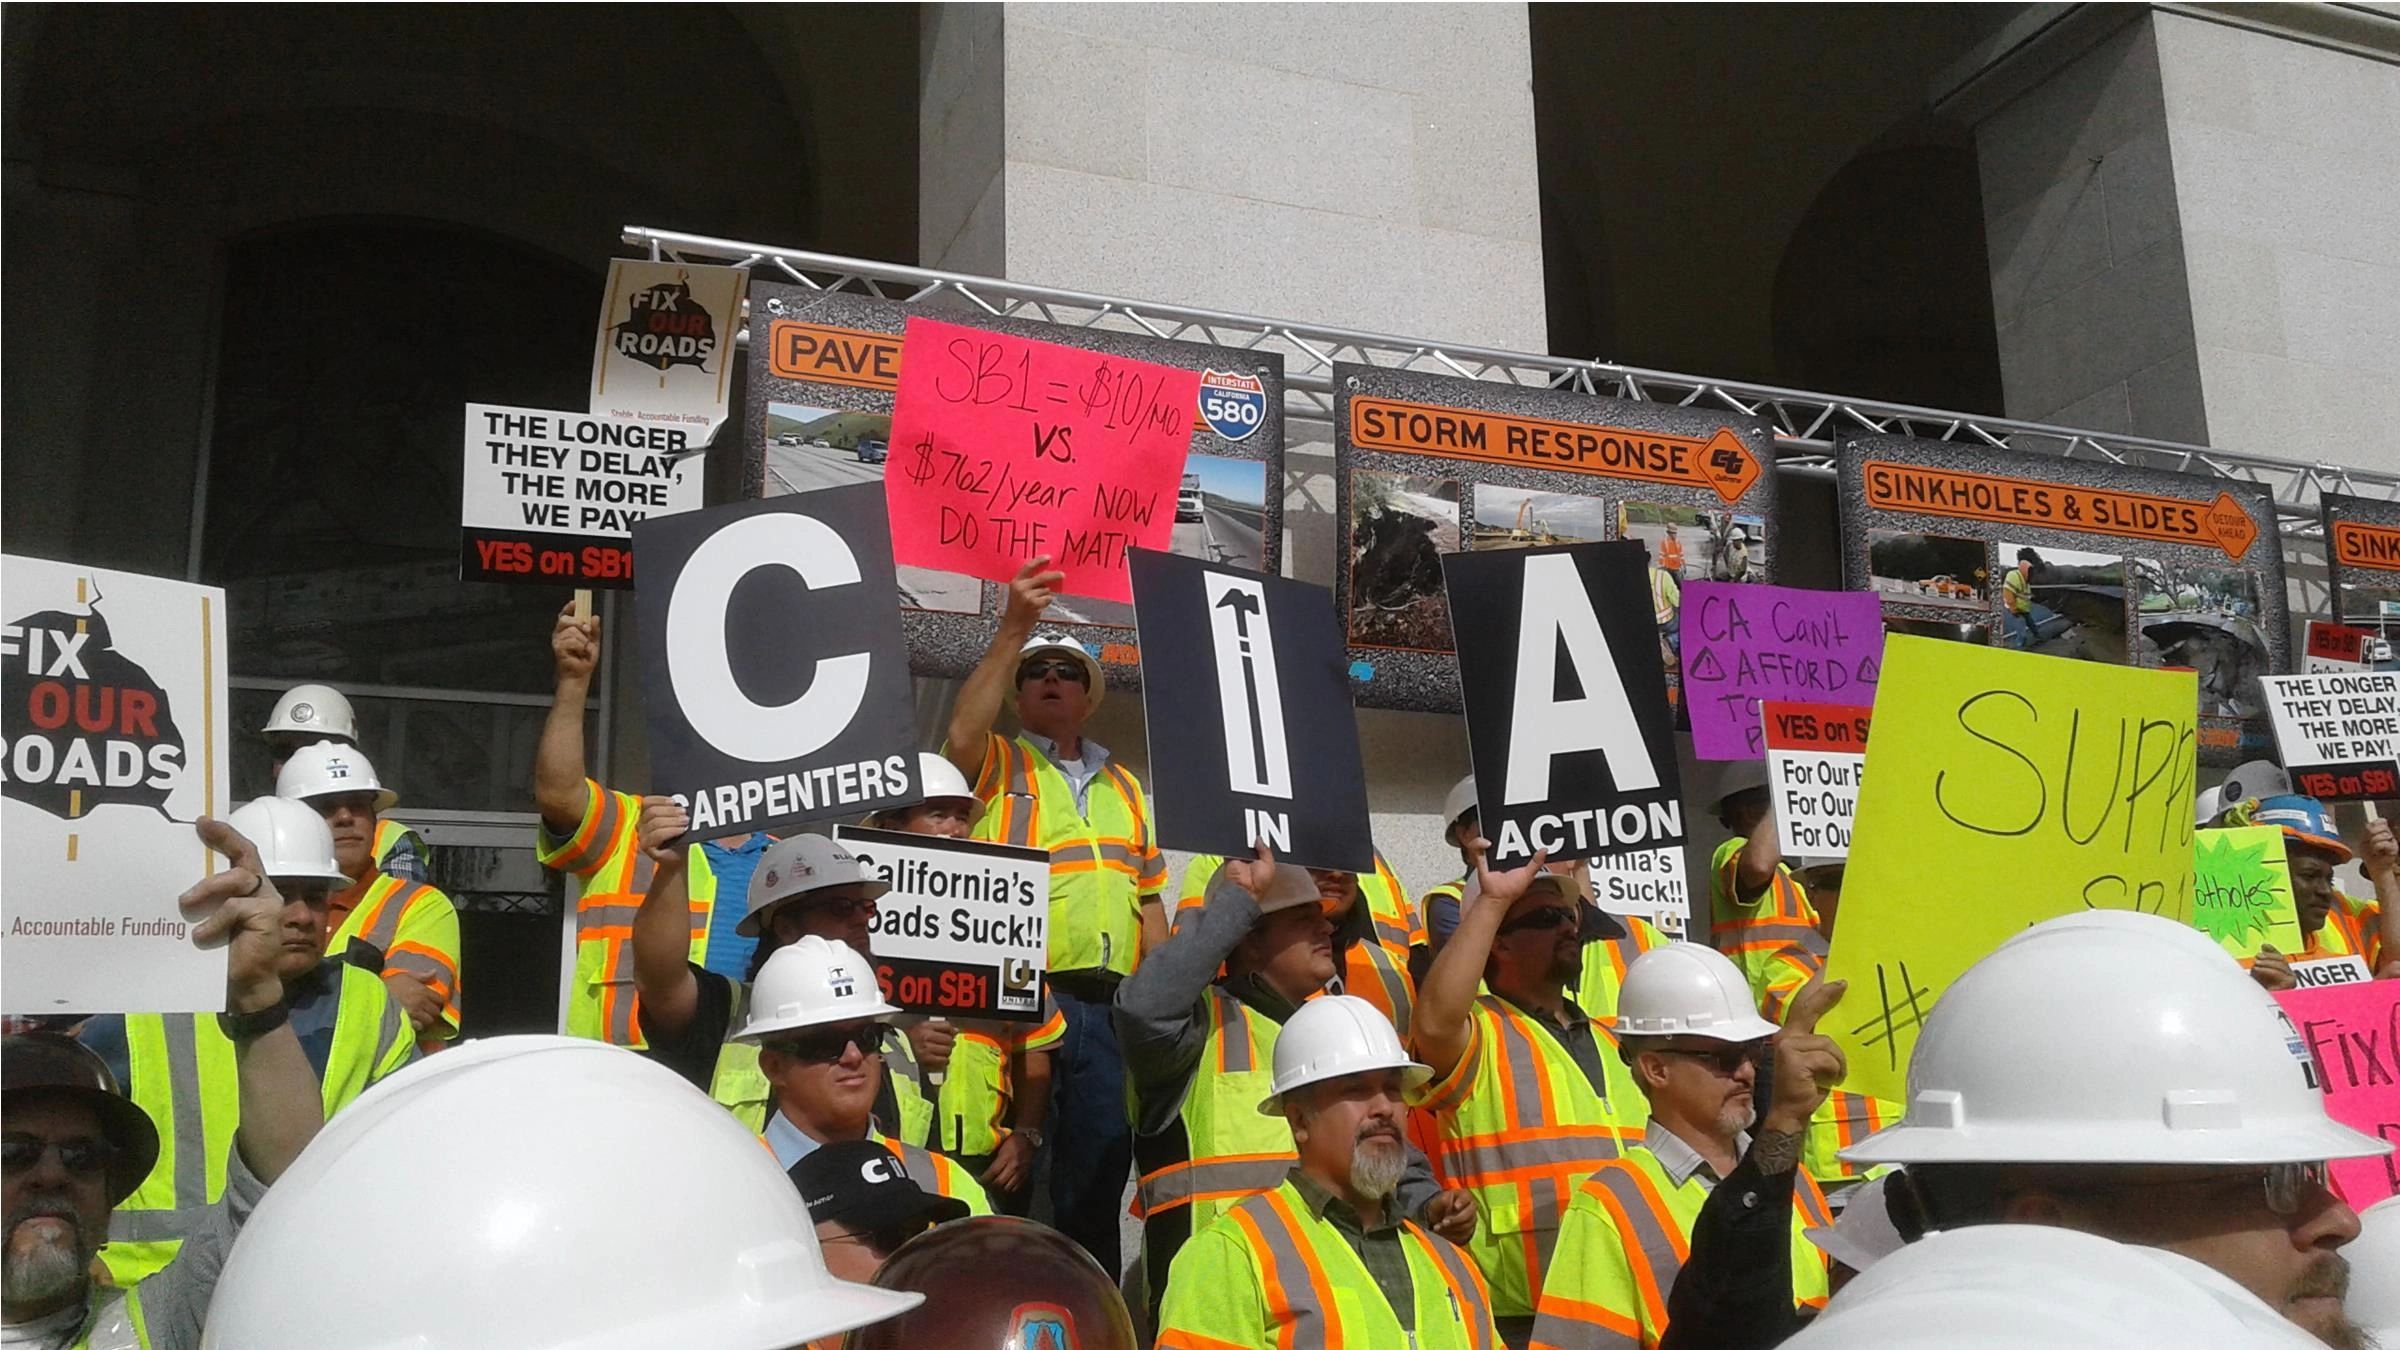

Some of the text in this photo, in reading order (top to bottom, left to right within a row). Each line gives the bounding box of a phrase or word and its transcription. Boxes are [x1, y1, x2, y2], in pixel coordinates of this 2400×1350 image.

[633, 291, 680, 312] FIX
[651, 312, 705, 335] OUR
[620, 332, 714, 358] ROADS
[790, 334, 898, 378] PAVE
[936, 339, 1038, 413] SB1
[1207, 375, 1256, 389] INTERSTATE
[1213, 389, 1250, 400] CALIFORNIA
[1207, 398, 1258, 425] 580
[484, 412, 687, 450] THE LONGER
[1363, 408, 1689, 474] STORM RESPONSE
[486, 441, 682, 485] THEY DELAY,
[502, 472, 668, 506] THE MORE
[905, 432, 1157, 527] $762/year NOW
[522, 502, 569, 527] WE
[1873, 471, 2198, 535] SINKHOLES & SLIDES
[941, 505, 978, 550] DO
[989, 518, 1047, 559] THE
[2213, 513, 2245, 527] DETOUR
[2218, 527, 2245, 540] AHEAD
[476, 540, 632, 578] YES on SB1
[1701, 596, 1752, 641] CA
[667, 512, 870, 762] C
[1504, 553, 1660, 806] A
[1737, 650, 1847, 691] AFFORD
[2275, 676, 2397, 697] THE LONGER
[29, 682, 159, 737] OUR
[2283, 699, 2331, 718] THEY
[1776, 714, 1871, 743] YES on S
[2298, 718, 2399, 739] THE MORE
[2317, 739, 2393, 760] WE PAY!
[1782, 759, 1813, 784] For
[1818, 761, 1849, 786] Our
[2300, 769, 2396, 796] YES on SB1
[1787, 790, 1853, 816] For Our
[1244, 808, 1291, 853] IN
[1496, 800, 1682, 860] ACTION
[1791, 821, 1821, 846] For
[1609, 877, 1683, 903] Suck!!
[2194, 872, 2273, 912] otholes
[11, 916, 186, 940] Accountable Funding
[950, 908, 1042, 948] Suck!!
[898, 974, 932, 1004] on
[938, 969, 987, 1008] SB1
